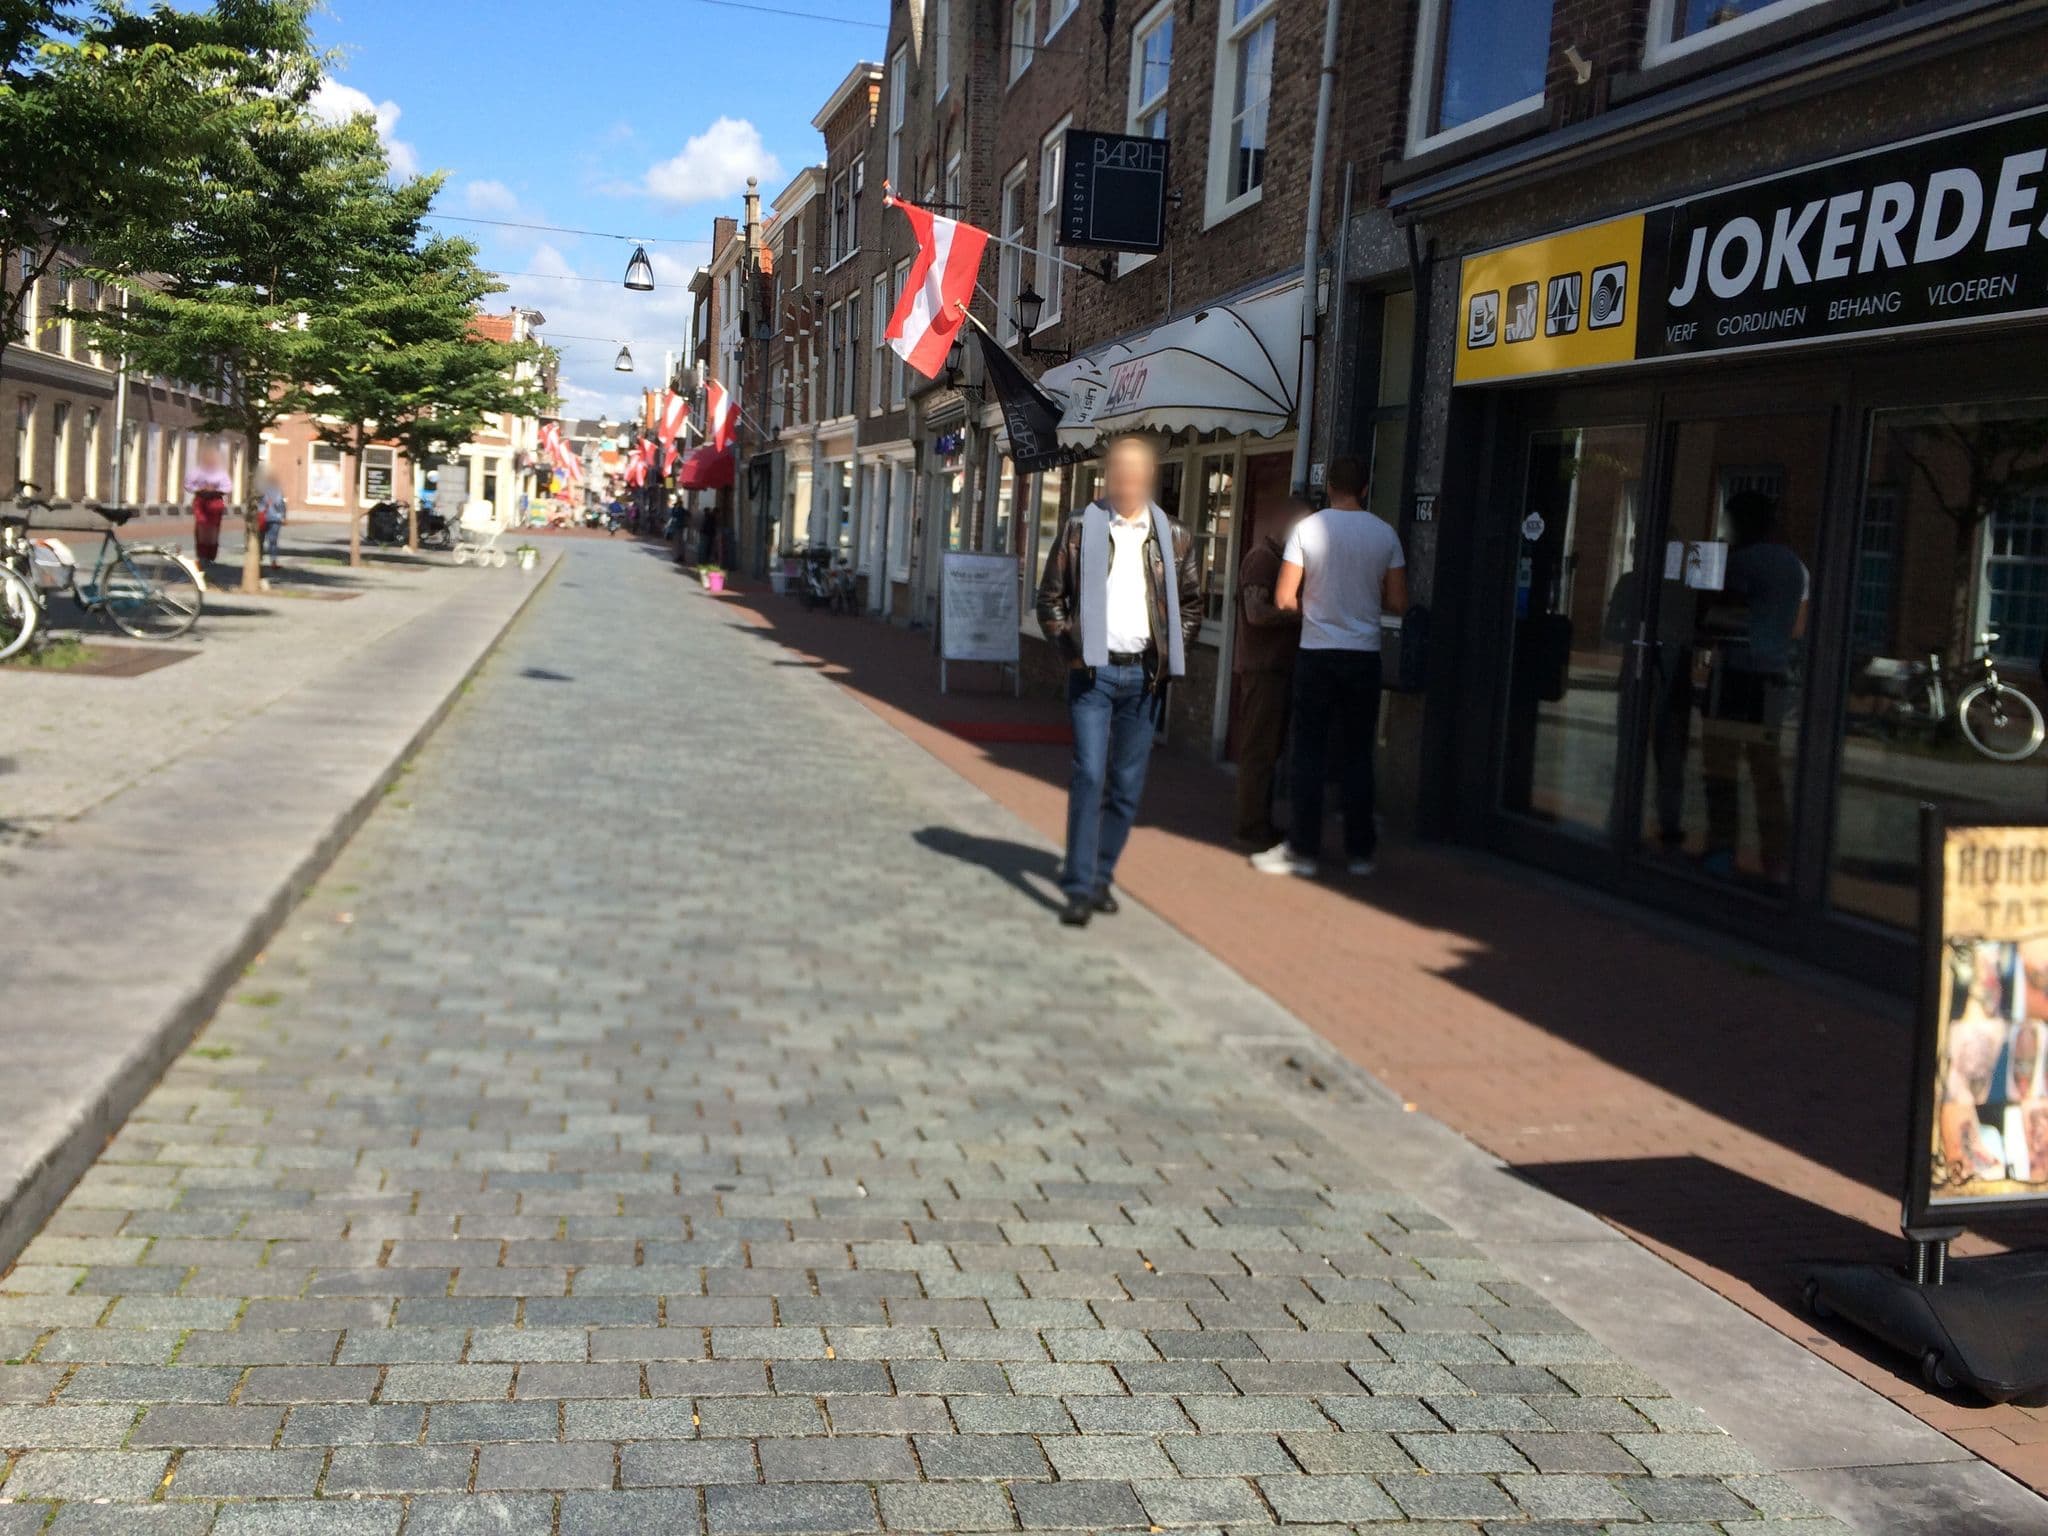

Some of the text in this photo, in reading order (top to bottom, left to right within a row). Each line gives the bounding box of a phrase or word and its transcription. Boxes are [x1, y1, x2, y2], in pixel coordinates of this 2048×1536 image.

[1093, 137, 1166, 171] BARTH
[1071, 161, 1086, 239] LIJSTEN
[1668, 148, 2048, 308] JOKERDE
[1666, 274, 2018, 343] VERF GORDIJNEN BEHANG VLOEREN
[1416, 501, 1433, 521] 164
